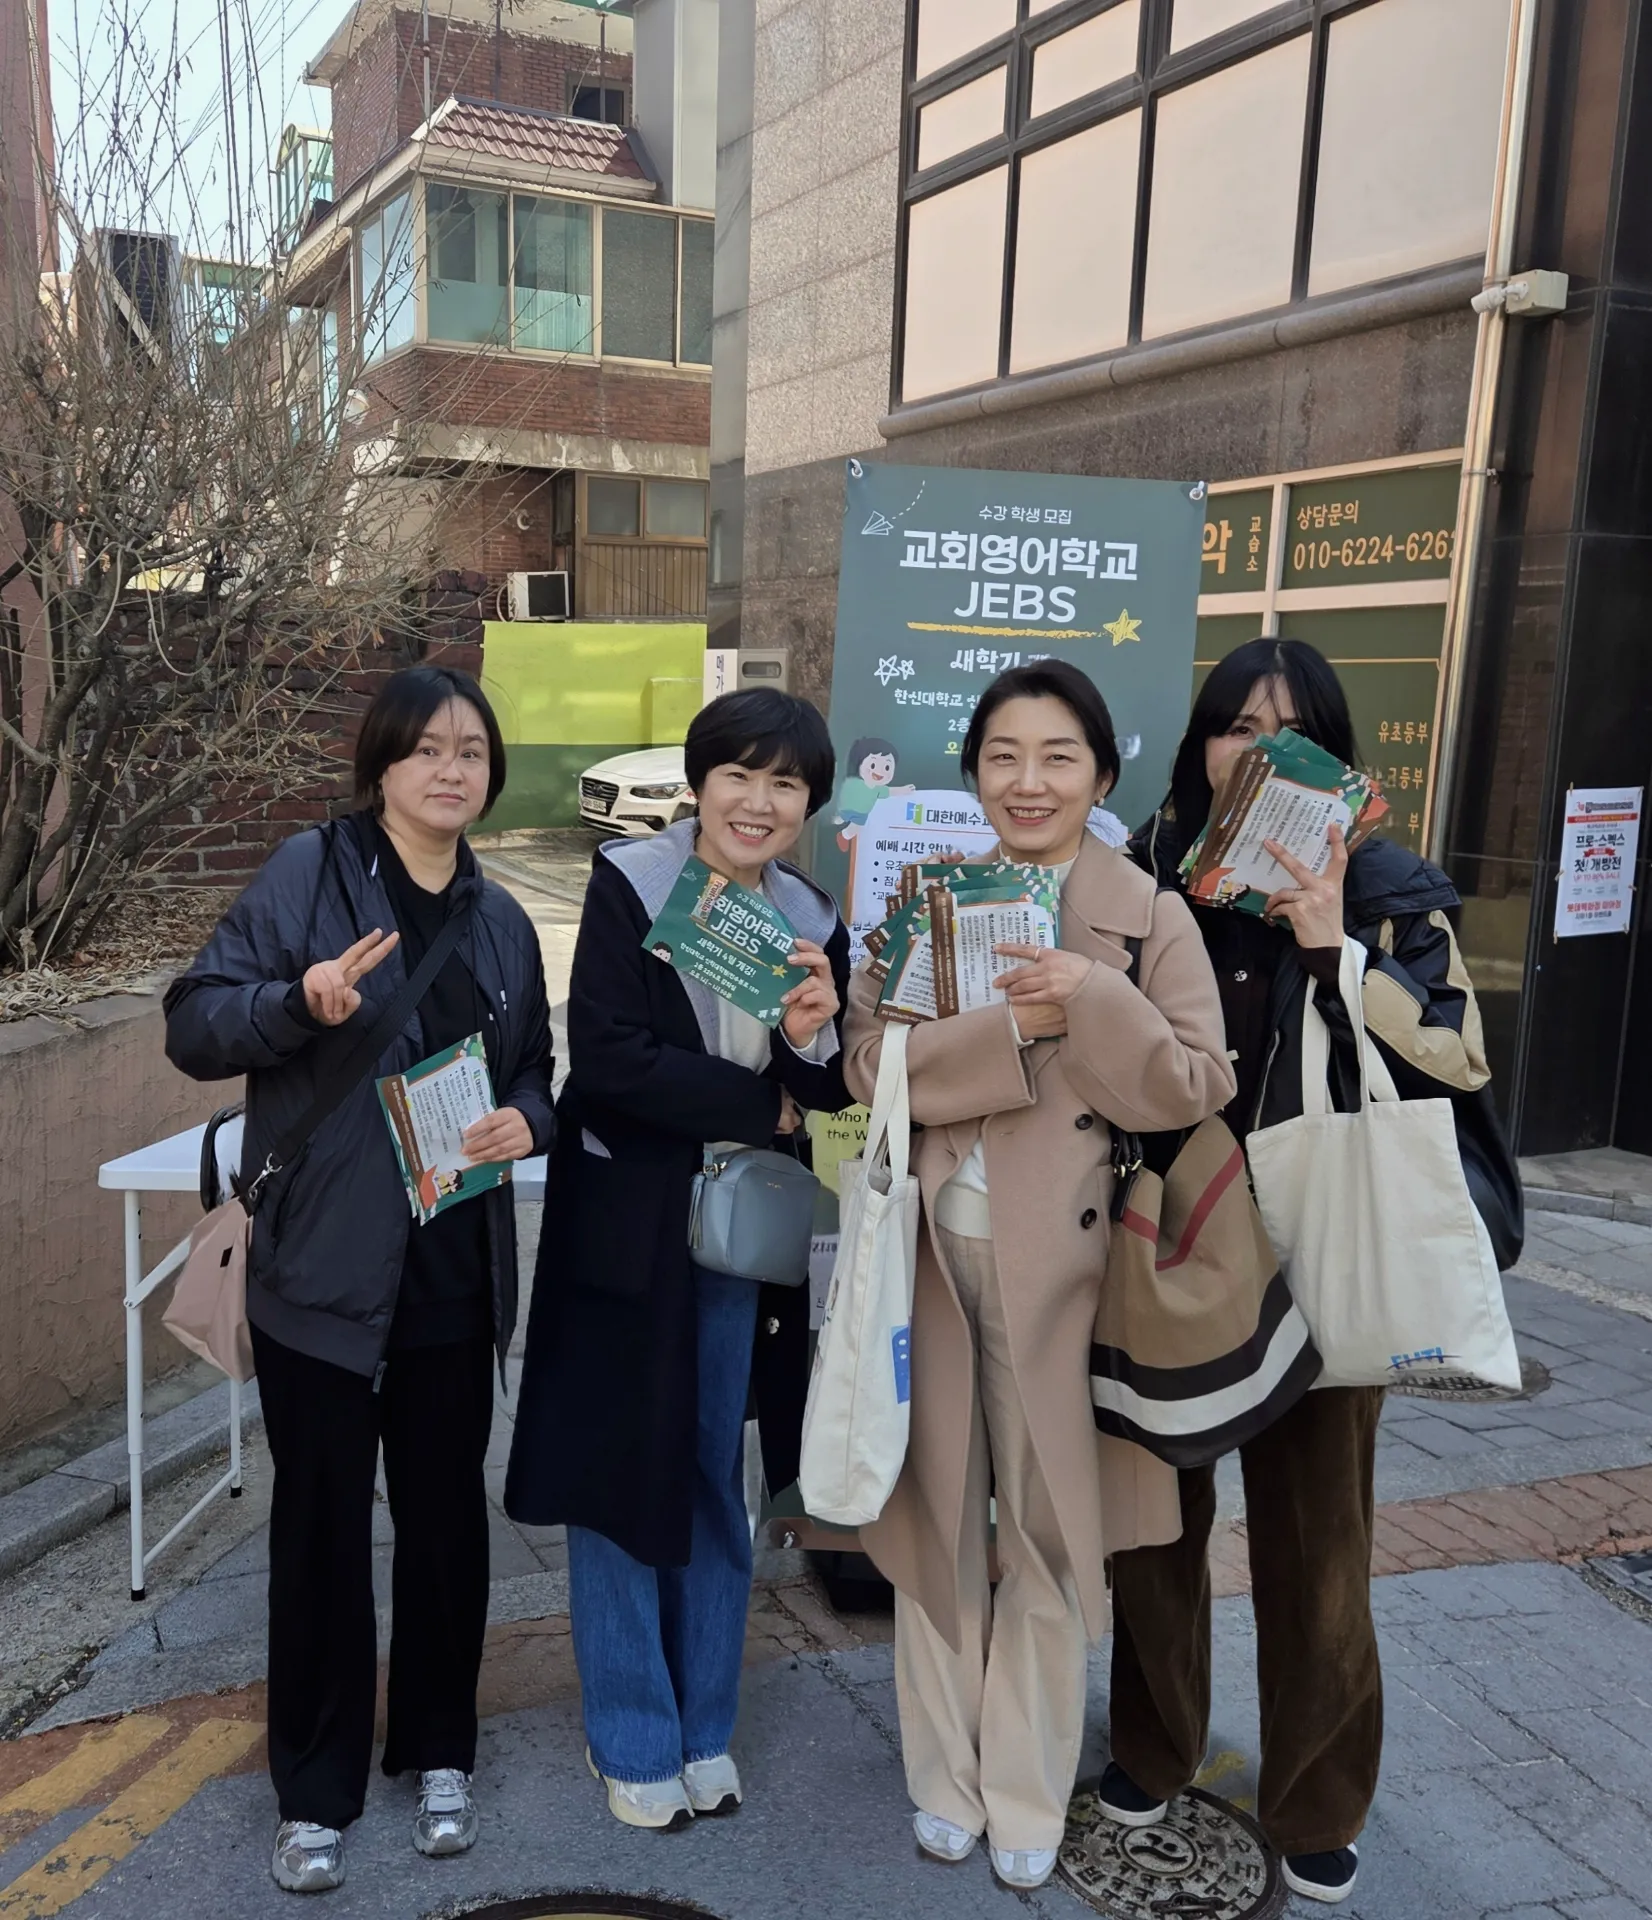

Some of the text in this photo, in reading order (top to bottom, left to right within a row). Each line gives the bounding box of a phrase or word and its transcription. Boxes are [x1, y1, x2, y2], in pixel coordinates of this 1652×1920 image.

[979, 506, 1072, 525] 수강 학생 모집
[1297, 500, 1360, 530] 상담문의
[899, 530, 1138, 581] 교회영어학교
[1246, 516, 1262, 572] 교습소
[953, 582, 1077, 623] JEBS
[950, 648, 1020, 674] 새학기
[894, 688, 964, 707] 한신대학교
[948, 717, 970, 733] 2층
[1378, 720, 1428, 744] 유초등부
[876, 840, 899, 852] 예배
[901, 841, 925, 854] 시간
[711, 916, 761, 953] JEBS
[714, 896, 791, 951] 회영어학교
[830, 1111, 862, 1123] Who
[827, 1129, 850, 1140] the
